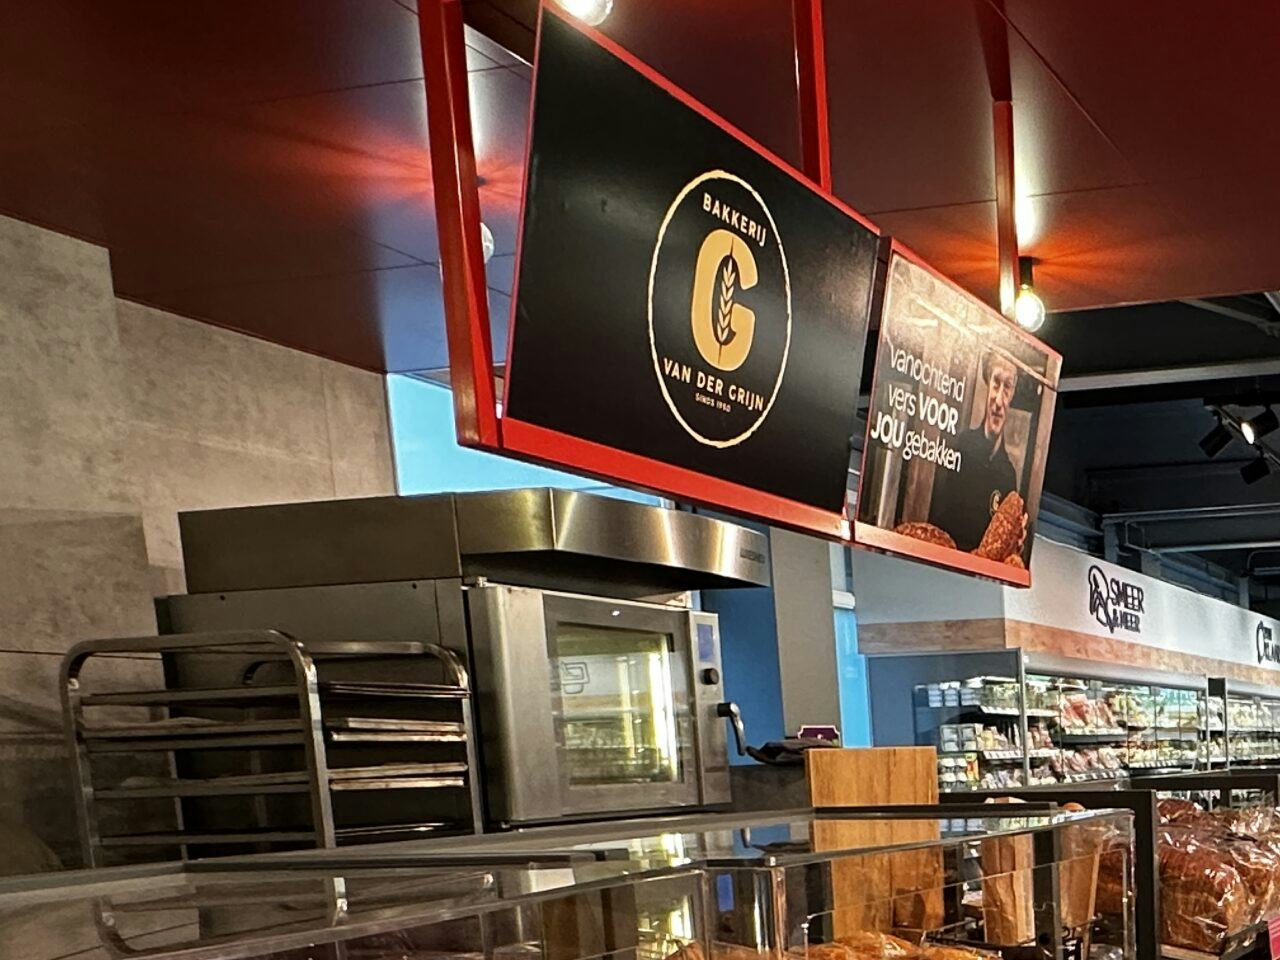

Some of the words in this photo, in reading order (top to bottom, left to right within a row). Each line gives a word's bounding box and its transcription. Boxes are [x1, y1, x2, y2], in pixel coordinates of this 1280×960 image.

[702, 192, 766, 247] BAKKERIJ
[663, 357, 692, 383] VAN
[696, 371, 724, 396] DER
[728, 384, 764, 411] GRIJN
[889, 344, 967, 403] vanochtend
[888, 383, 917, 417] vers
[918, 391, 959, 435] VOOR
[870, 411, 906, 448] JOU
[902, 430, 962, 473] gebakken
[1110, 577, 1145, 614] SMEER
